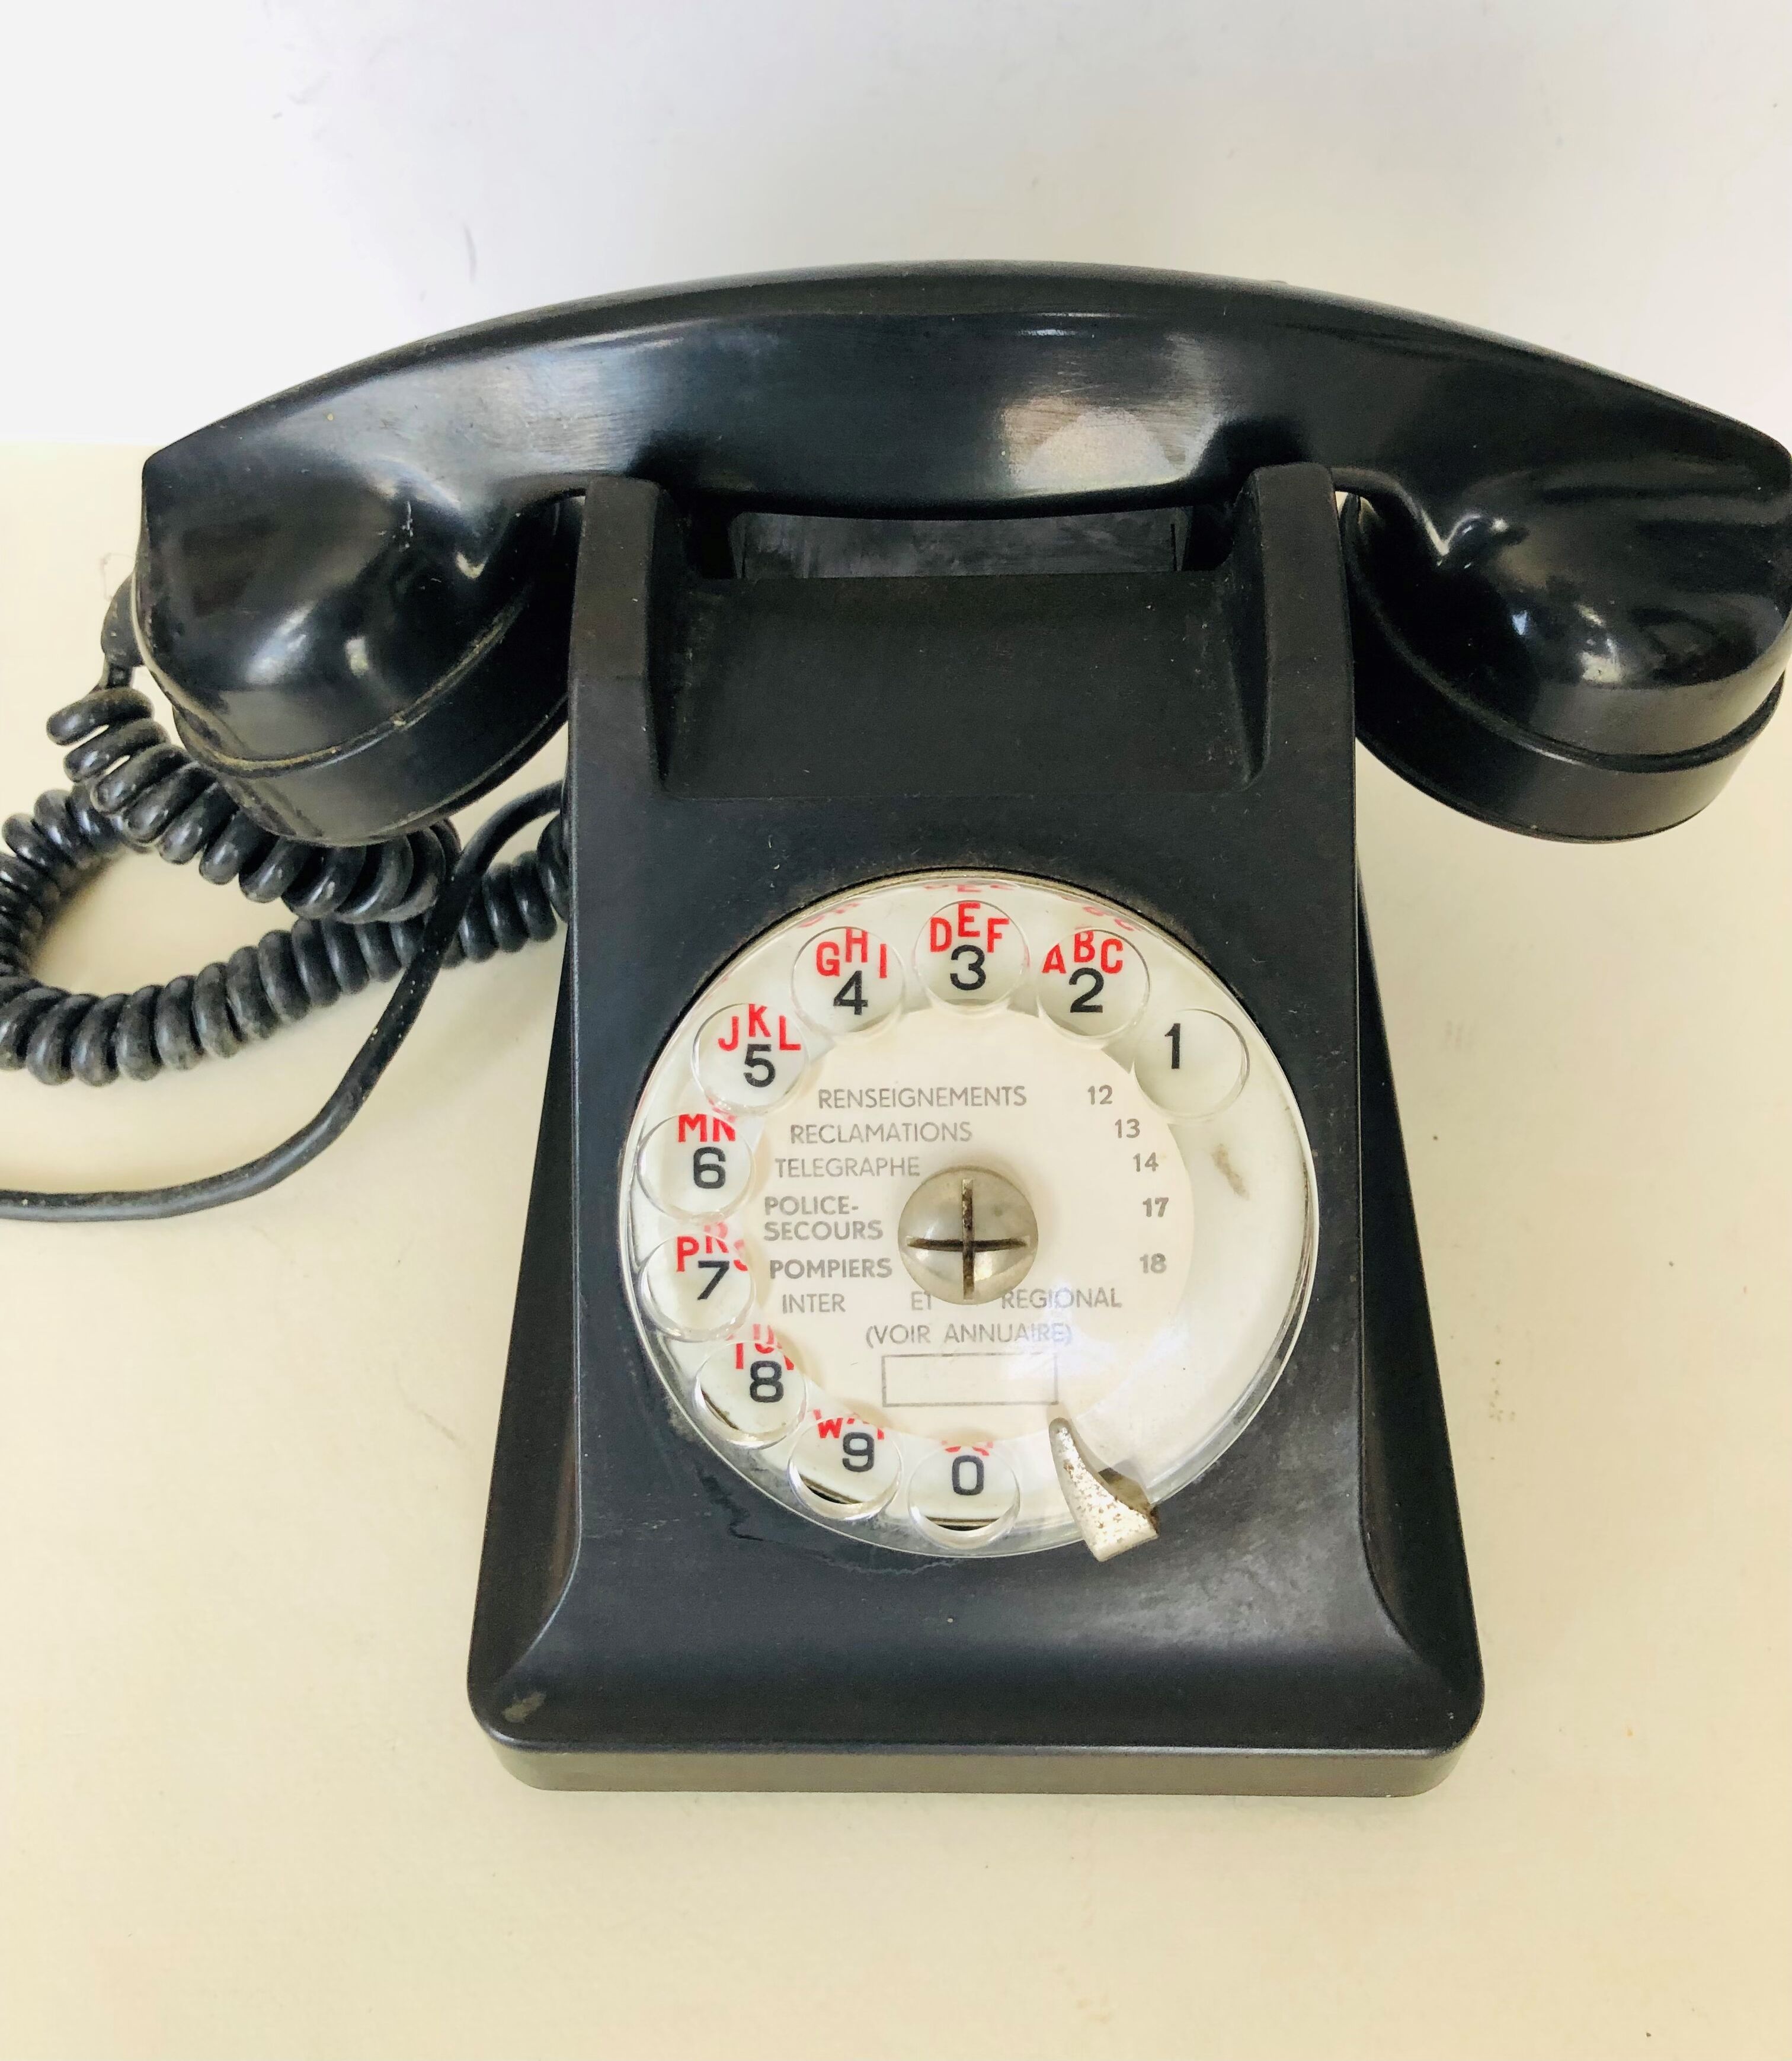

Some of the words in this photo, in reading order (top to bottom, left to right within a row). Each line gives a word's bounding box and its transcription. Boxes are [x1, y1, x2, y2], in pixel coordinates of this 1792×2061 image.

[930, 900, 1010, 953] DEF
[815, 928, 888, 980] GHI
[950, 944, 987, 991] 3
[1041, 929, 1124, 975] ABC
[833, 970, 868, 1015] 4
[1068, 967, 1104, 1013] 2
[718, 1003, 802, 1052] JKL
[1164, 1023, 1180, 1070] 1
[744, 1044, 776, 1087] 5
[818, 1086, 1027, 1109] RENSEIGNEMENTS
[1087, 1084, 1113, 1106] 12
[790, 1121, 972, 1144] RECLAMATIONS
[1114, 1118, 1141, 1139] 13
[693, 1147, 725, 1189] 6
[775, 1156, 920, 1178] TELEGRAPHE
[1132, 1151, 1160, 1173] 14
[764, 1195, 859, 1216] POLICE-
[1142, 1196, 1169, 1218] 17
[763, 1220, 884, 1241] SECOURS
[697, 1260, 729, 1300] 7
[769, 1257, 892, 1280] POMPIERS
[1139, 1253, 1167, 1274] 18
[782, 1293, 846, 1314] INTER
[1001, 1287, 1122, 1310] REGIONAL
[865, 1324, 931, 1349] (VOIR
[943, 1323, 1072, 1348] ANNUAIRE)
[749, 1361, 784, 1403] 8
[842, 1432, 874, 1473] 9
[952, 1455, 984, 1496] 0
